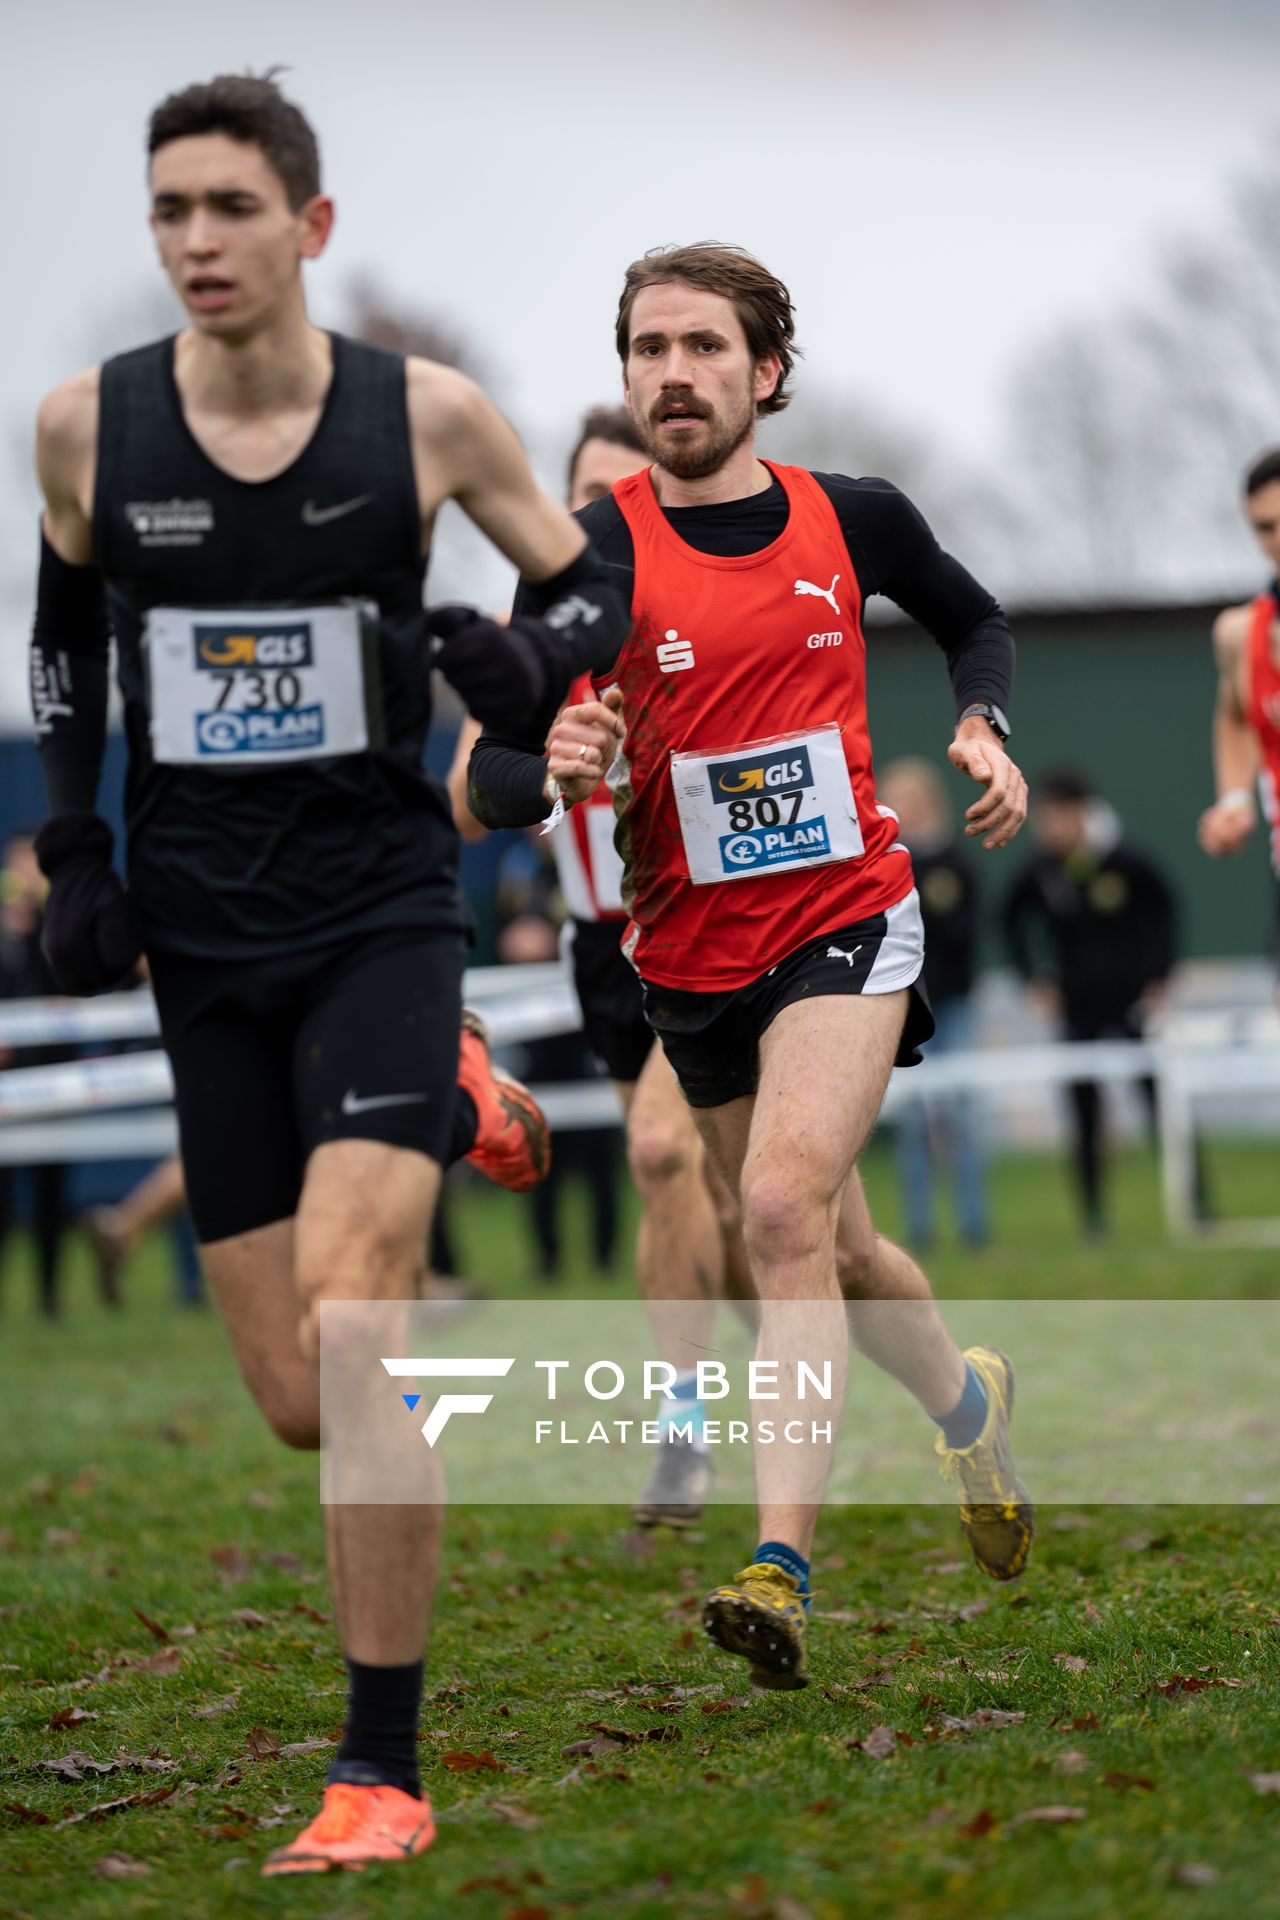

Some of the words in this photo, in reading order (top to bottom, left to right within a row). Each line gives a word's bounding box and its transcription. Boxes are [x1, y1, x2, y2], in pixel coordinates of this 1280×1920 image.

[256, 634, 306, 665] GLS
[210, 670, 302, 713] 730
[247, 712, 320, 738] PLAN
[765, 760, 803, 787] GLS
[728, 790, 804, 833] 807
[764, 825, 825, 851] PLAN
